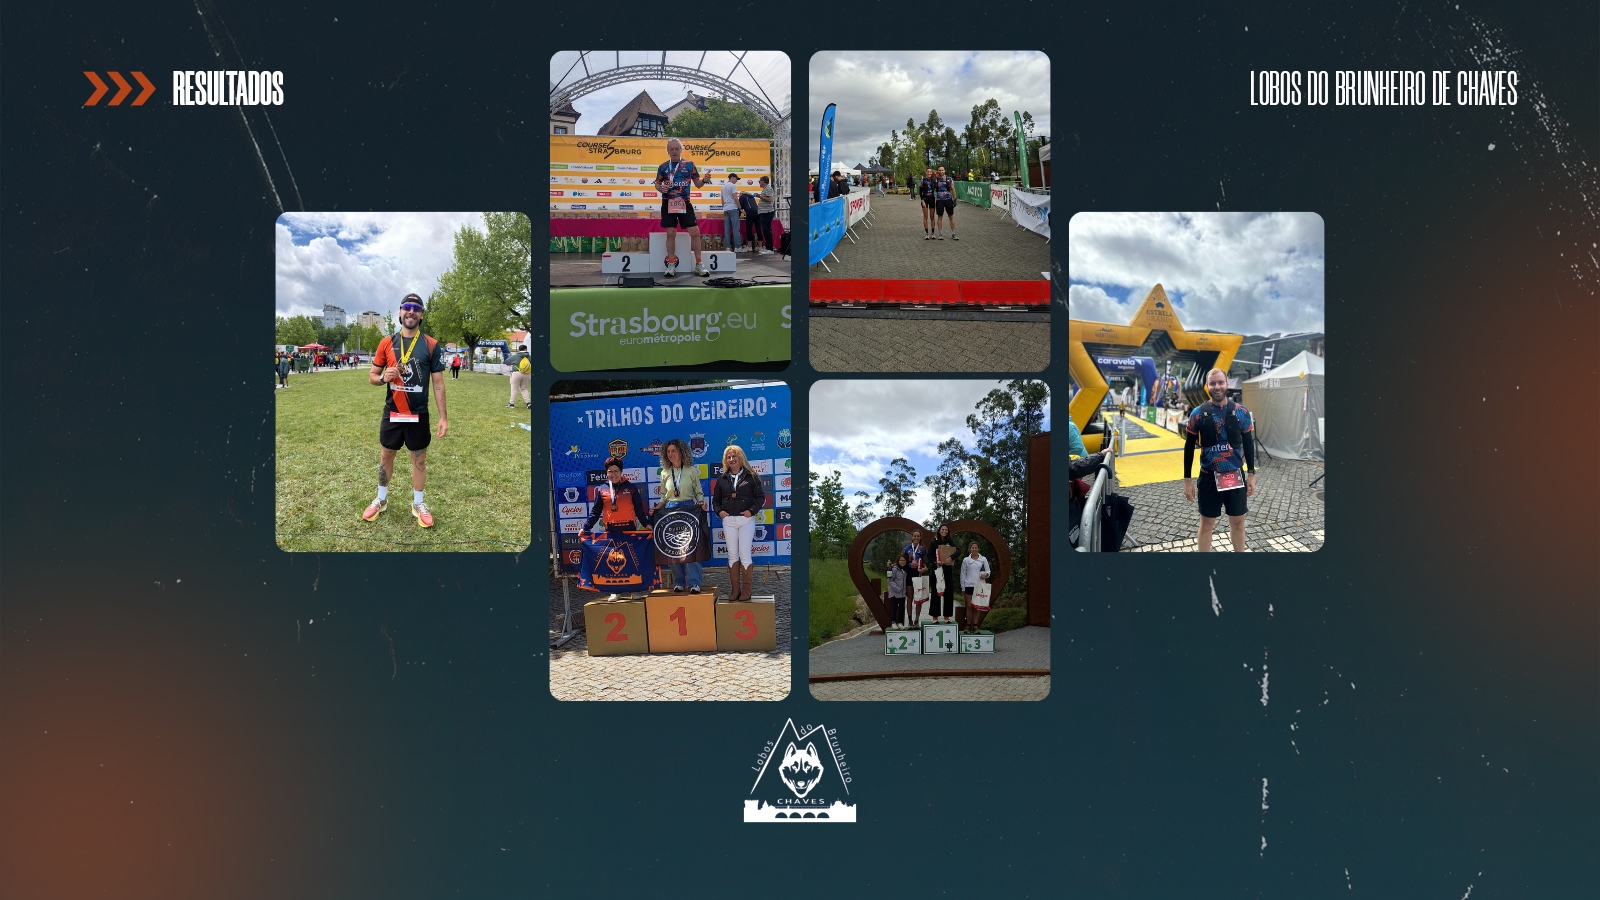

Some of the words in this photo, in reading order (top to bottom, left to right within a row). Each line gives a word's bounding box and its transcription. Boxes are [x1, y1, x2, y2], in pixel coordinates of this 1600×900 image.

[622, 255, 631, 272] 2
[709, 254, 718, 271] 3
[1146, 309, 1173, 318] ESTRELA
[569, 307, 757, 342] Strasbourg.eu
[619, 331, 701, 346] eurométropole
[1097, 357, 1136, 366] caravela
[585, 405, 654, 428] TRILHOS
[661, 403, 684, 424] DO
[689, 396, 768, 422] CEIREIRO
[604, 612, 629, 642] 2
[669, 606, 688, 637] 1
[732, 609, 758, 641] 3
[898, 635, 908, 650] 2
[935, 630, 944, 648] 1
[974, 638, 981, 650] 3
